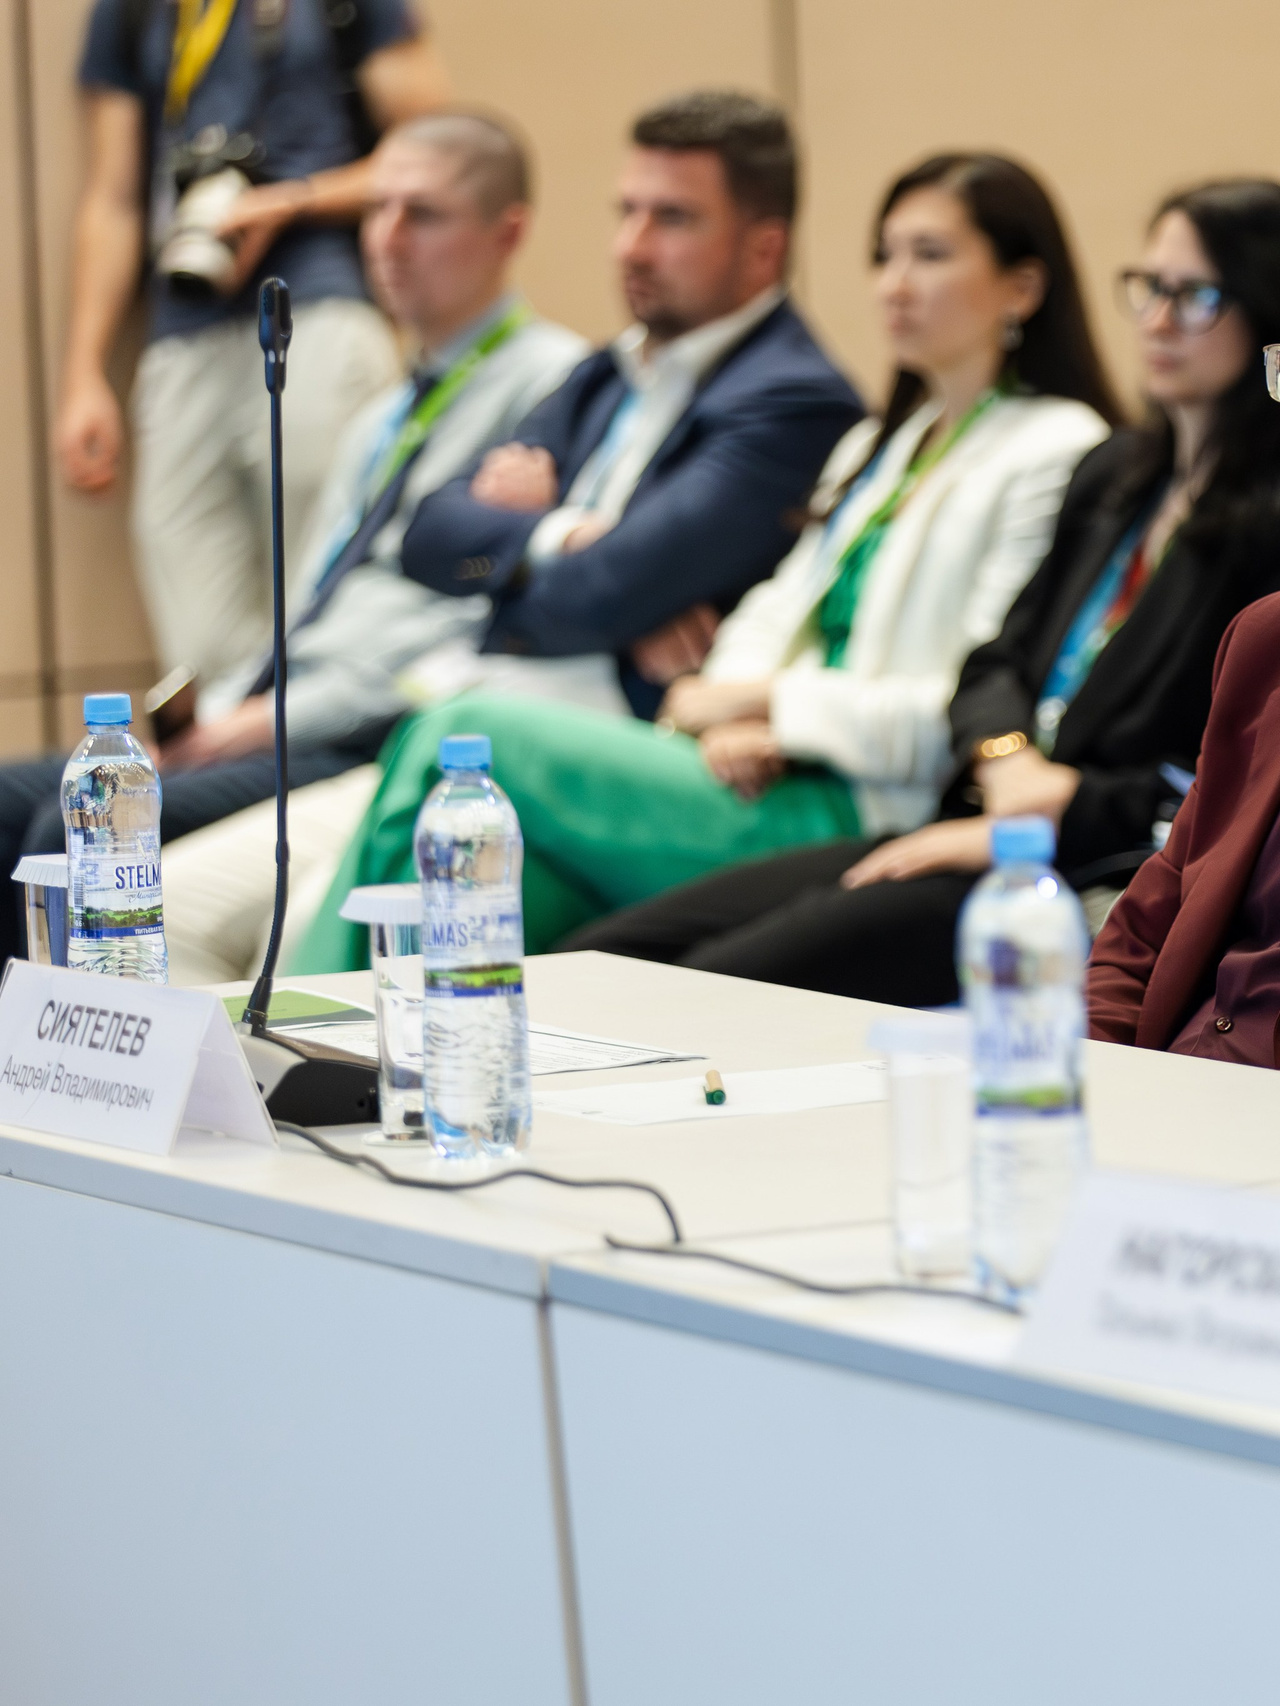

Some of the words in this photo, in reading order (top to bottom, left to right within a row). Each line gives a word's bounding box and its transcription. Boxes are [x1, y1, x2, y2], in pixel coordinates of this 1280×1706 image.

[37, 999, 152, 1057] СИЯТЕЛЕВ
[0, 1055, 52, 1095] Андрей
[51, 1063, 154, 1112] Владимирович
